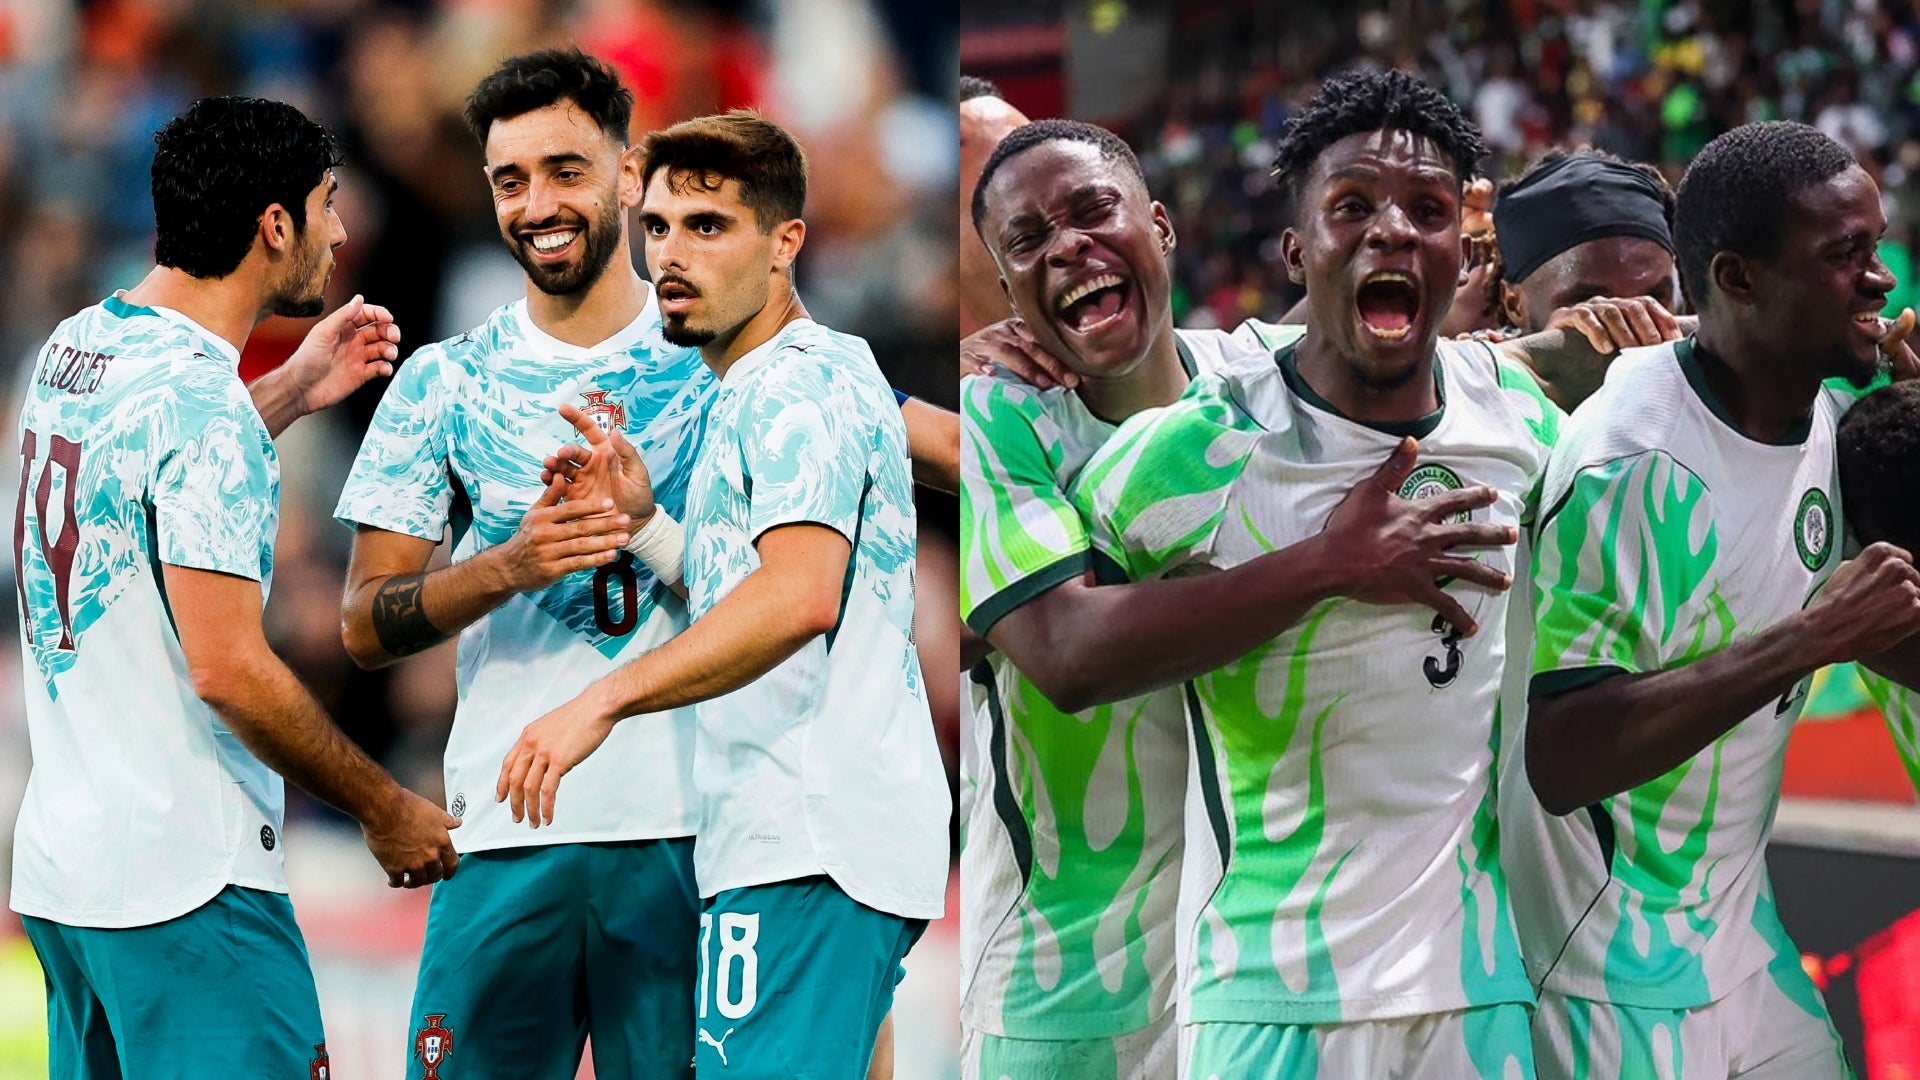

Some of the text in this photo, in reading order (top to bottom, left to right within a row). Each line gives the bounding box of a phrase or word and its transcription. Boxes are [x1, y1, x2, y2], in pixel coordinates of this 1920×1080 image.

[13, 429, 82, 651] 19
[593, 550, 638, 637] 8
[1423, 613, 1464, 688] 3
[699, 912, 759, 1019] 18
